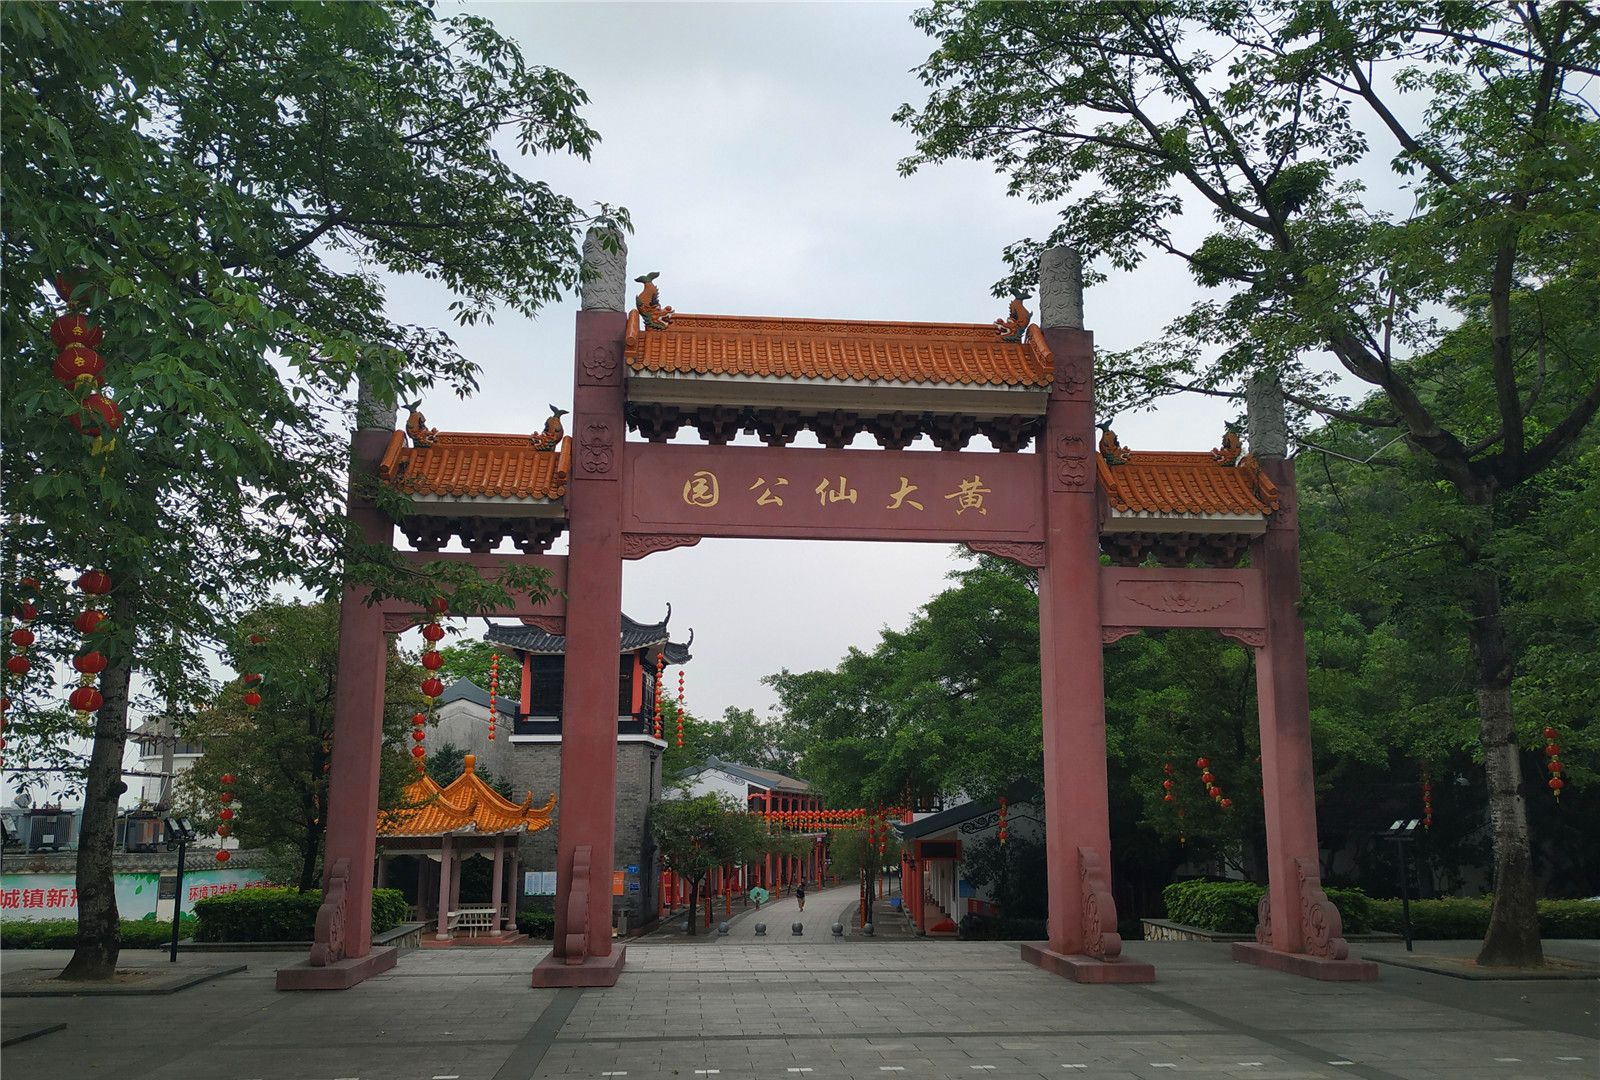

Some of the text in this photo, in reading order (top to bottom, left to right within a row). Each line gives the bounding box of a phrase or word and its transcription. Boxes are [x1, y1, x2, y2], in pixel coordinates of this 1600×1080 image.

[683, 470, 992, 515] 黄大仙公园
